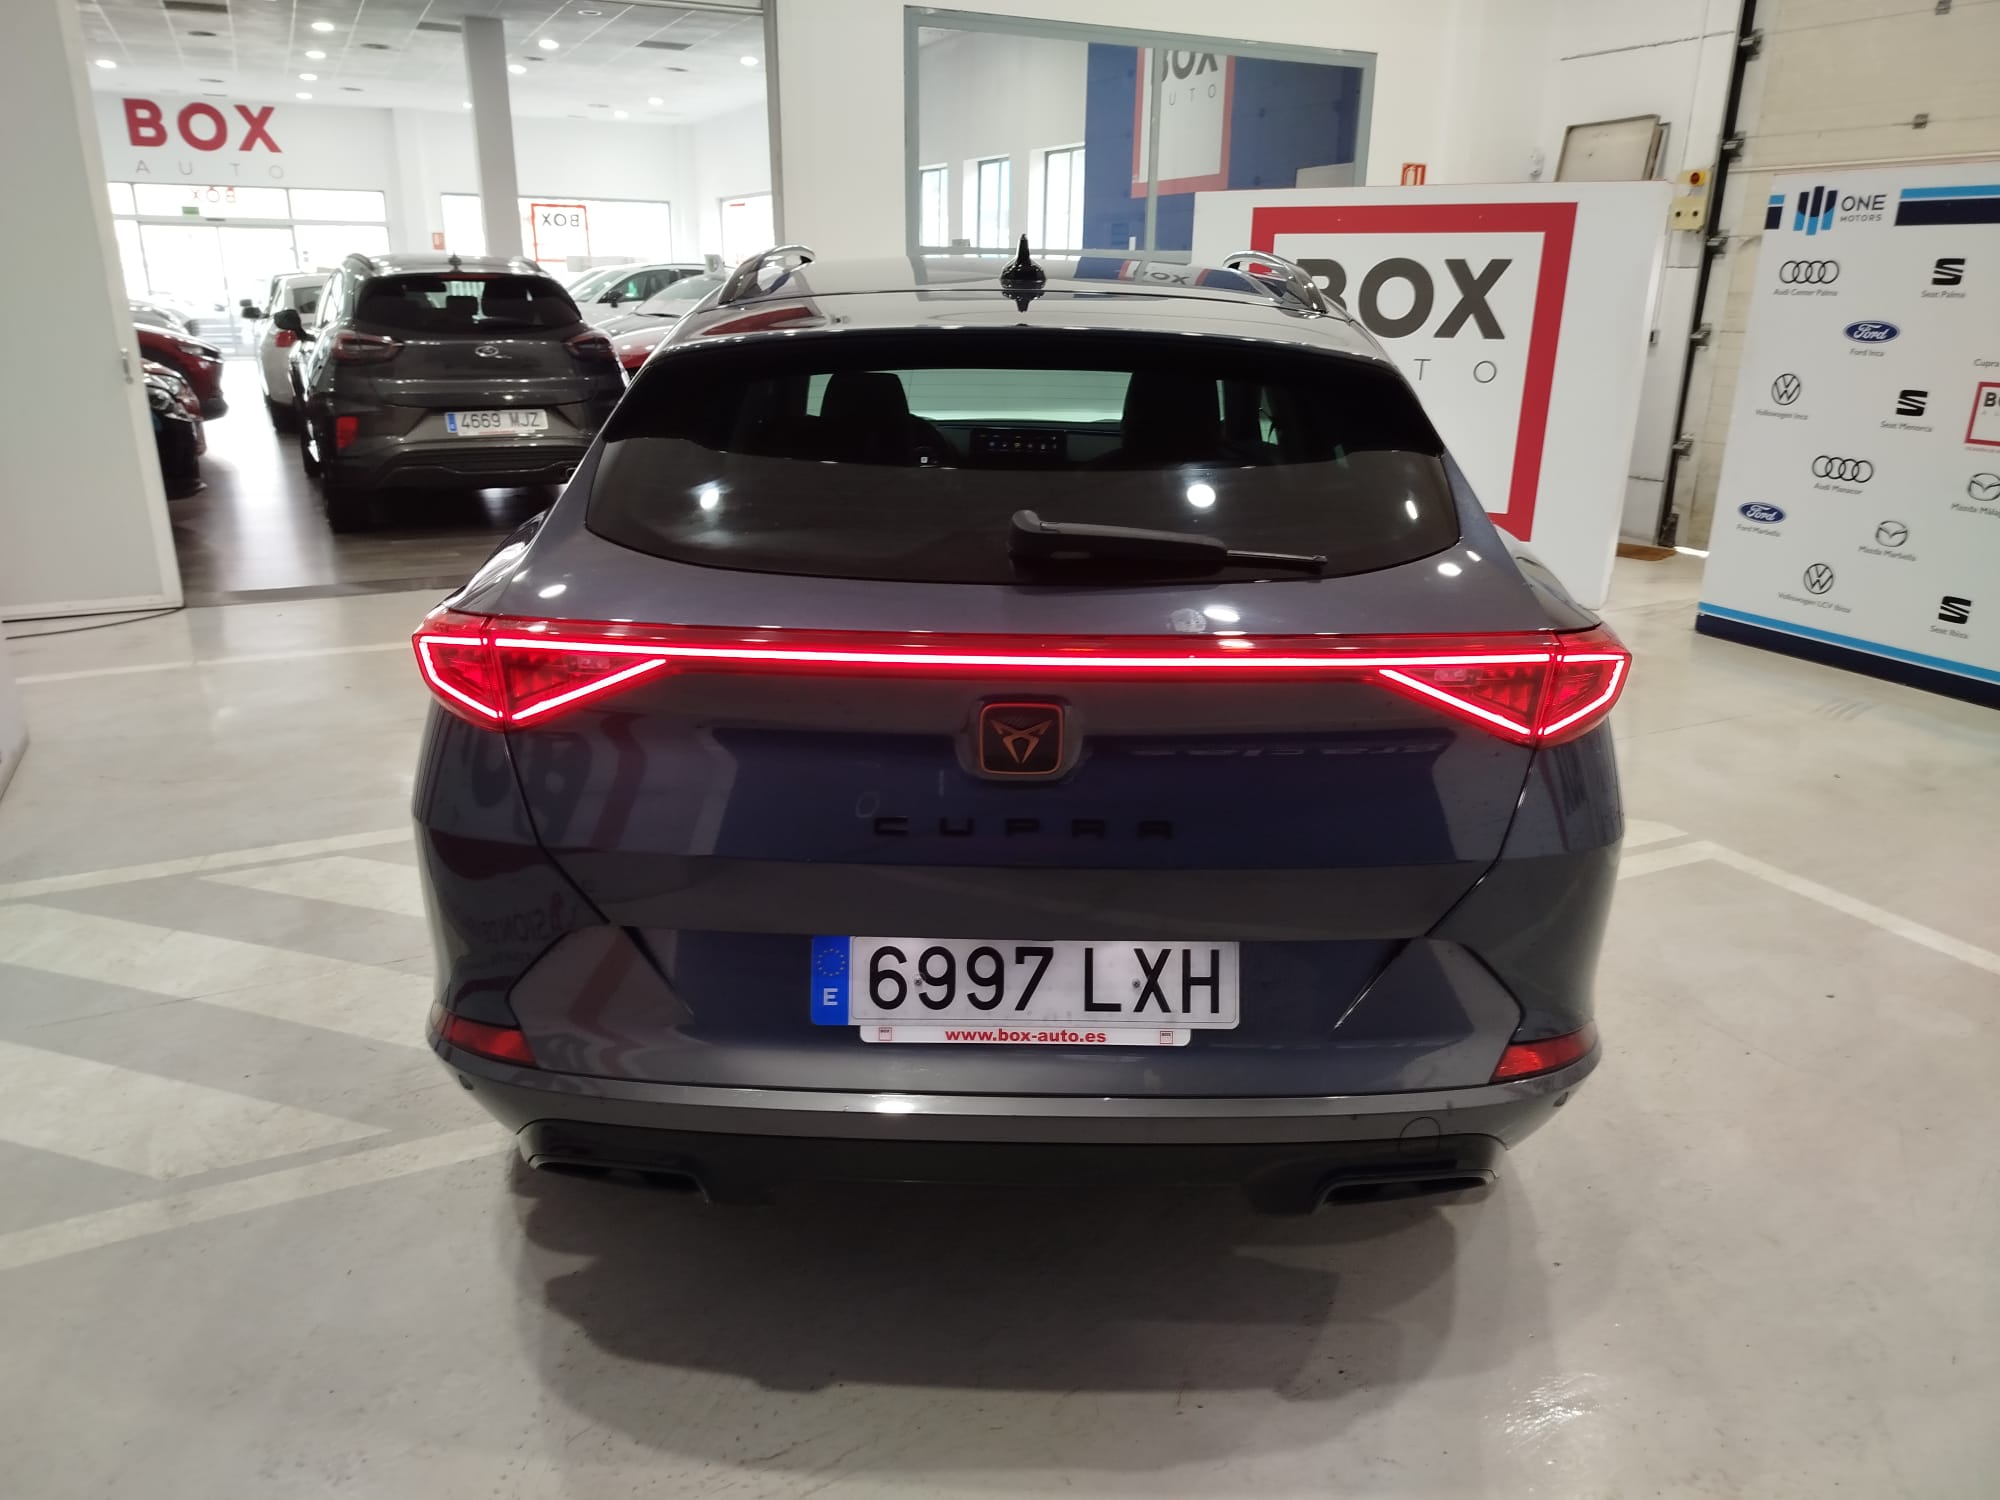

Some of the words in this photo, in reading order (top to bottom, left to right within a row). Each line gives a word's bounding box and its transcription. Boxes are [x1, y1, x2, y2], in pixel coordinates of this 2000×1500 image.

[122, 97, 283, 153] BOX
[135, 159, 284, 179] AUTO
[1841, 194, 1887, 212] ONE
[1840, 214, 1882, 223] MOTORS
[1853, 323, 1889, 340] Ford
[1984, 391, 2000, 408] B
[461, 413, 501, 428] 4669
[1746, 504, 1778, 521] Ford
[874, 817, 1174, 840] CUPRA
[869, 945, 1054, 1011] 6997
[1084, 947, 1221, 1014] LXH
[823, 988, 838, 1006] E
[945, 1028, 1106, 1044] www.box-auto.es
